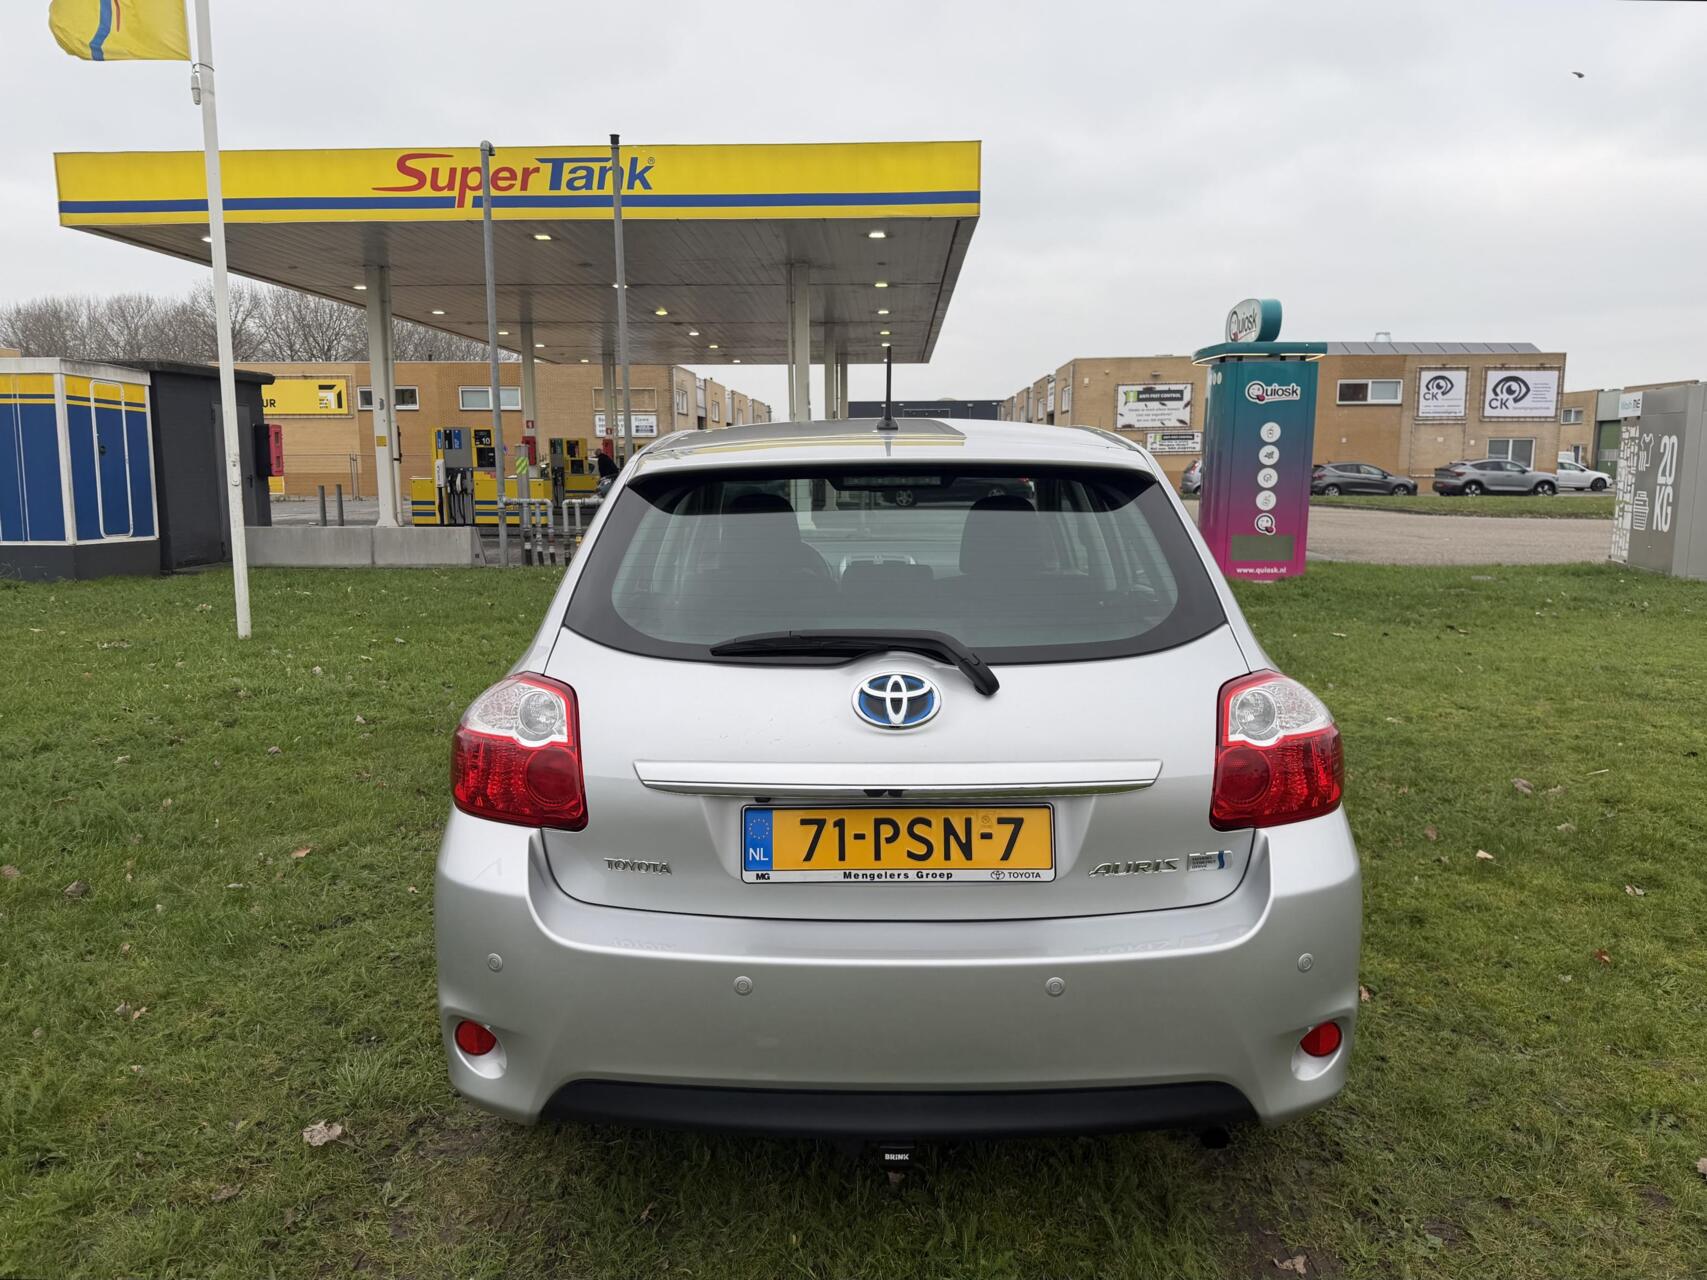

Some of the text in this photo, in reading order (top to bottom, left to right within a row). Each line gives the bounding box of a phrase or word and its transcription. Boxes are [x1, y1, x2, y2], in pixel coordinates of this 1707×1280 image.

[1229, 308, 1257, 342] Quiosk
[1246, 382, 1299, 402] Quiosk
[1423, 391, 1439, 401] CK
[1488, 397, 1509, 410] CK
[1656, 434, 1678, 486] 20
[1652, 485, 1673, 533] KG
[1236, 566, 1287, 575] www.quiosk.nl
[800, 817, 1024, 862] 71-PSN-7
[749, 848, 769, 861] NL
[603, 857, 672, 876] TOYOTA
[1088, 858, 1180, 878] AURIS
[755, 872, 771, 881] MG
[843, 871, 953, 881] Mengelers Groep
[1008, 871, 1042, 879] TOYOTA
